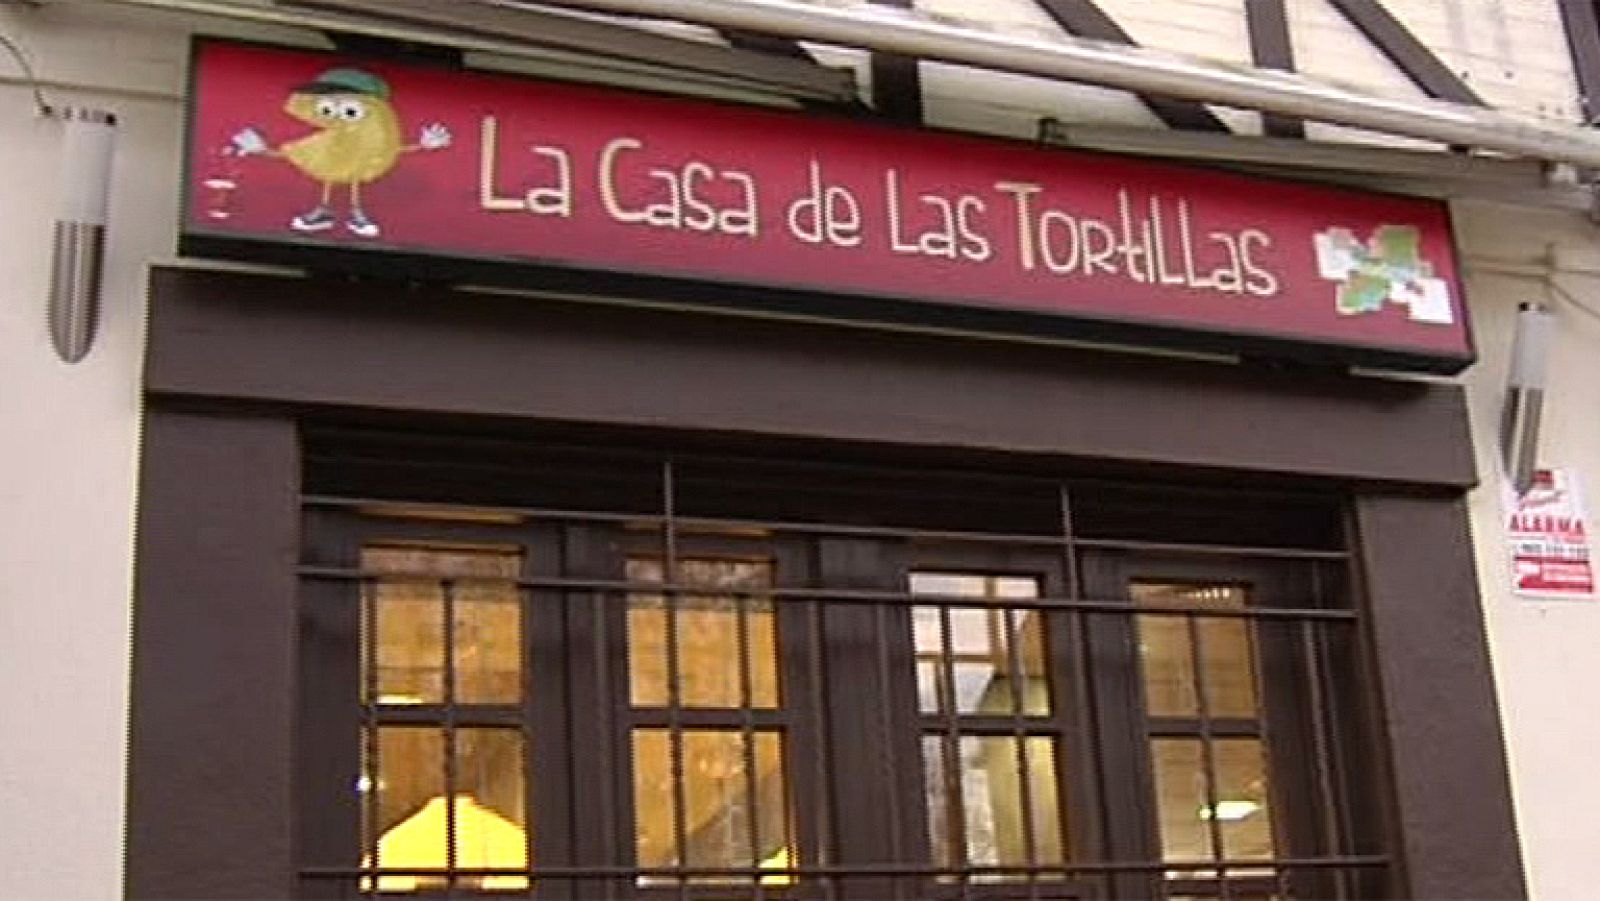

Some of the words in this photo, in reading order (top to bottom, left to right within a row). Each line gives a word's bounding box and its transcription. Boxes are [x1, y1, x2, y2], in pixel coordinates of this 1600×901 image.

[479, 115, 572, 218] La
[600, 137, 758, 237] Casa
[787, 157, 863, 246] de
[886, 168, 991, 262] Las
